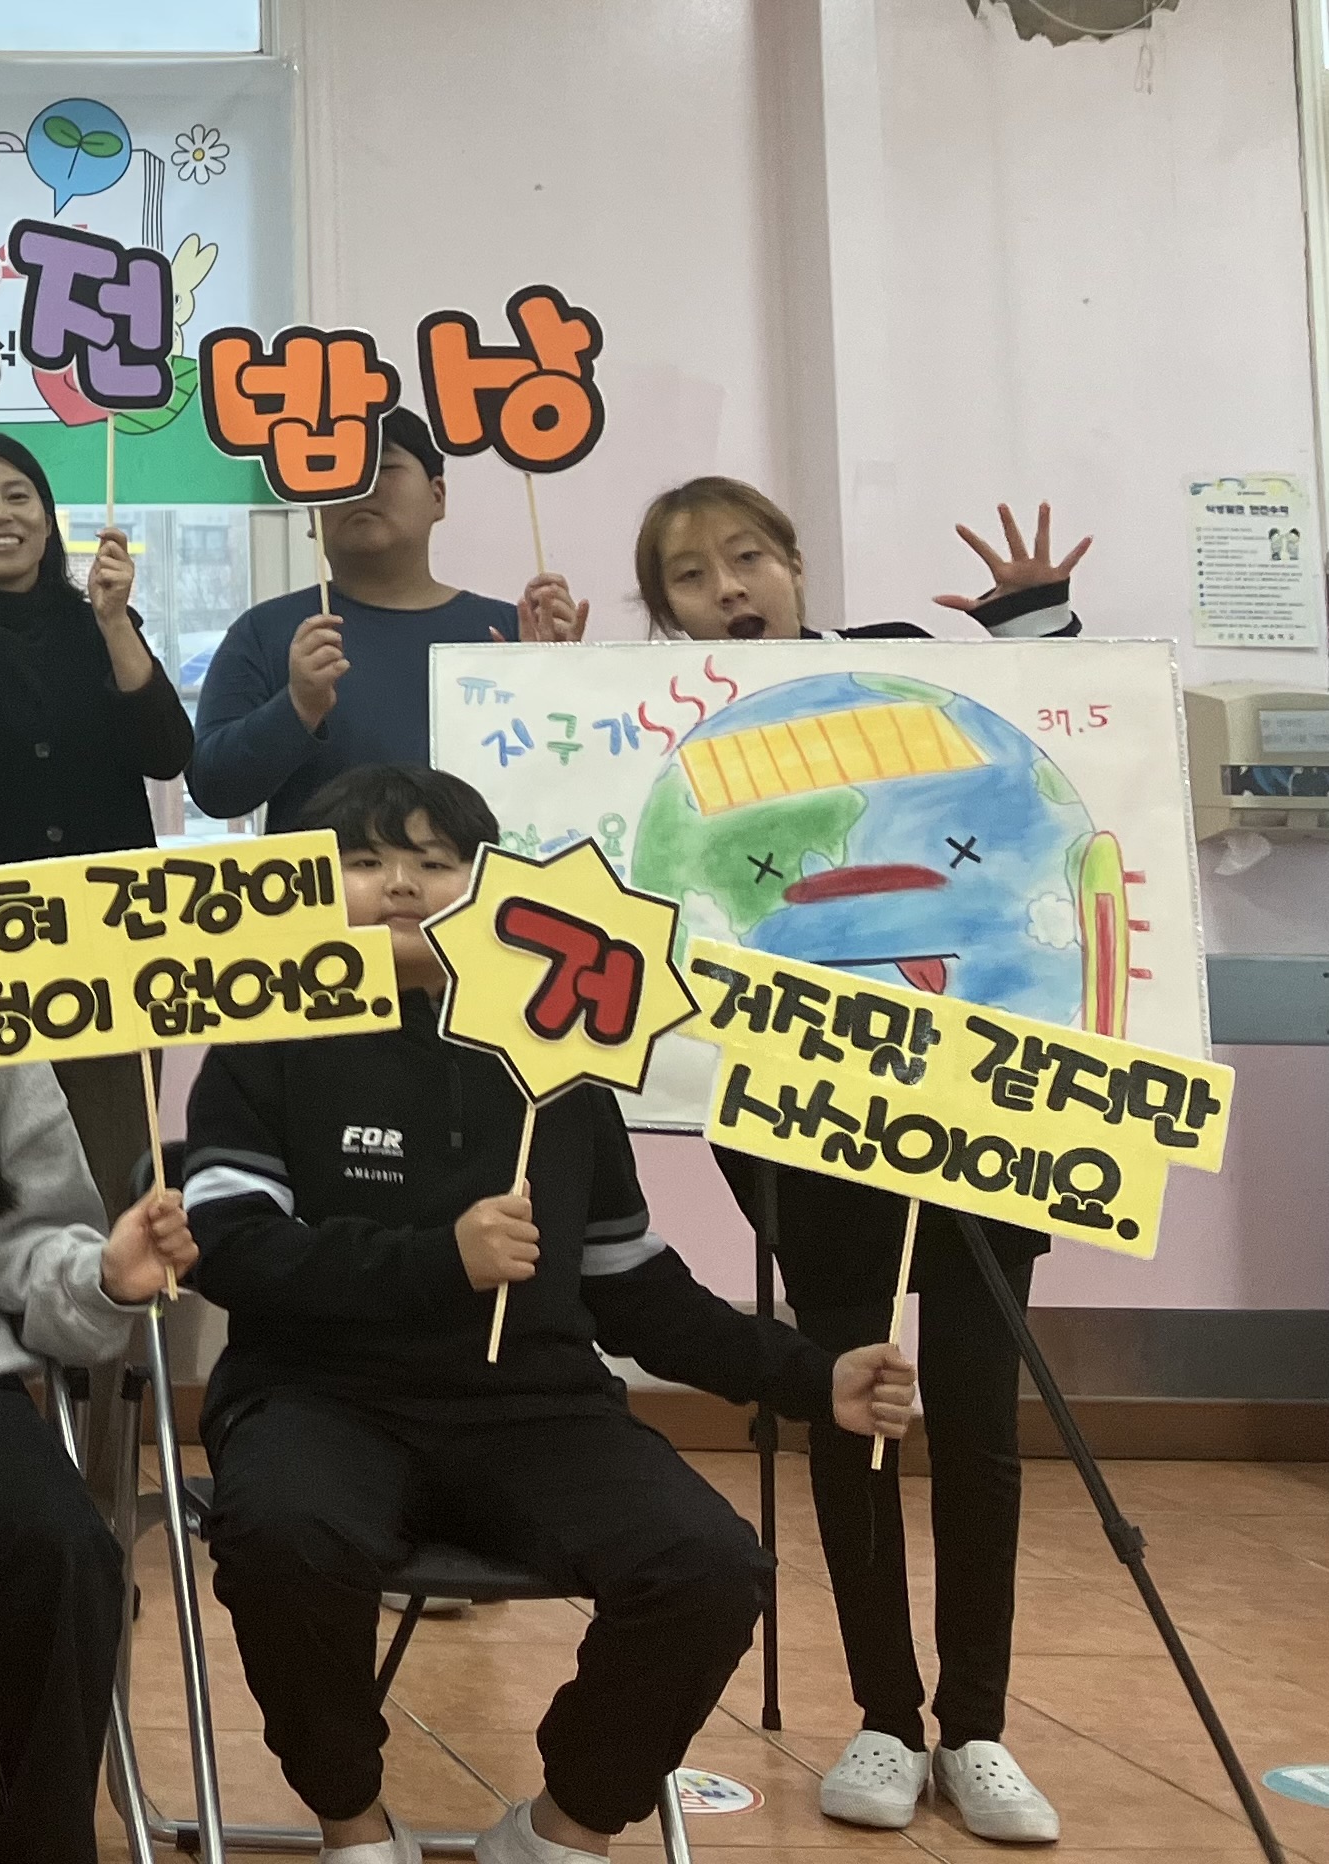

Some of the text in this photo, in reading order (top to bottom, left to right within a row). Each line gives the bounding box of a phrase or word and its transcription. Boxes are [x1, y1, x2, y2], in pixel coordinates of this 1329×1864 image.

[481, 711, 640, 768] 지구가
[1037, 704, 1112, 737] 37.5
[85, 856, 335, 941] 건강에
[133, 941, 393, 1037] 없어요.
[495, 896, 644, 1046] 거
[691, 958, 1222, 1148] 거짓말 같지만
[341, 1125, 404, 1149] FOR
[720, 1064, 1140, 1241] 사실이에요.
